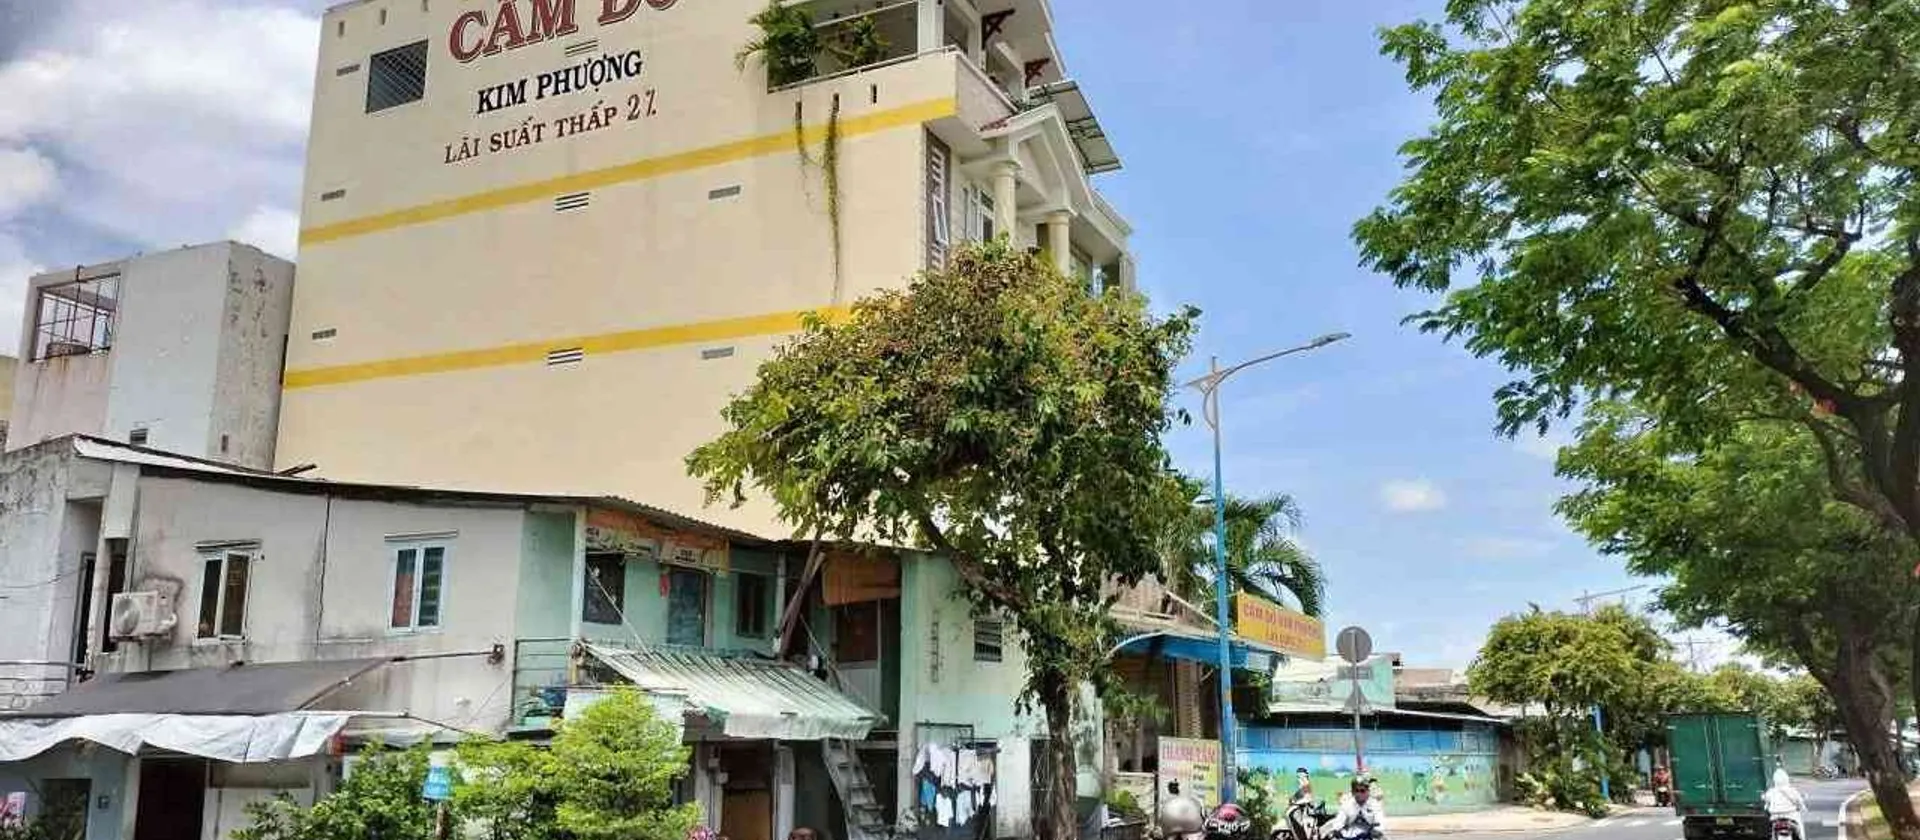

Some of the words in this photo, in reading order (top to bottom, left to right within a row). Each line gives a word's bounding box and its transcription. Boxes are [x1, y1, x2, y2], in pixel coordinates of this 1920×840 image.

[476, 78, 528, 115] KIM
[535, 50, 643, 100] PHƯỢNG
[444, 137, 480, 164] LÃI
[489, 116, 546, 152] SUẤT
[554, 101, 618, 138] THẤP
